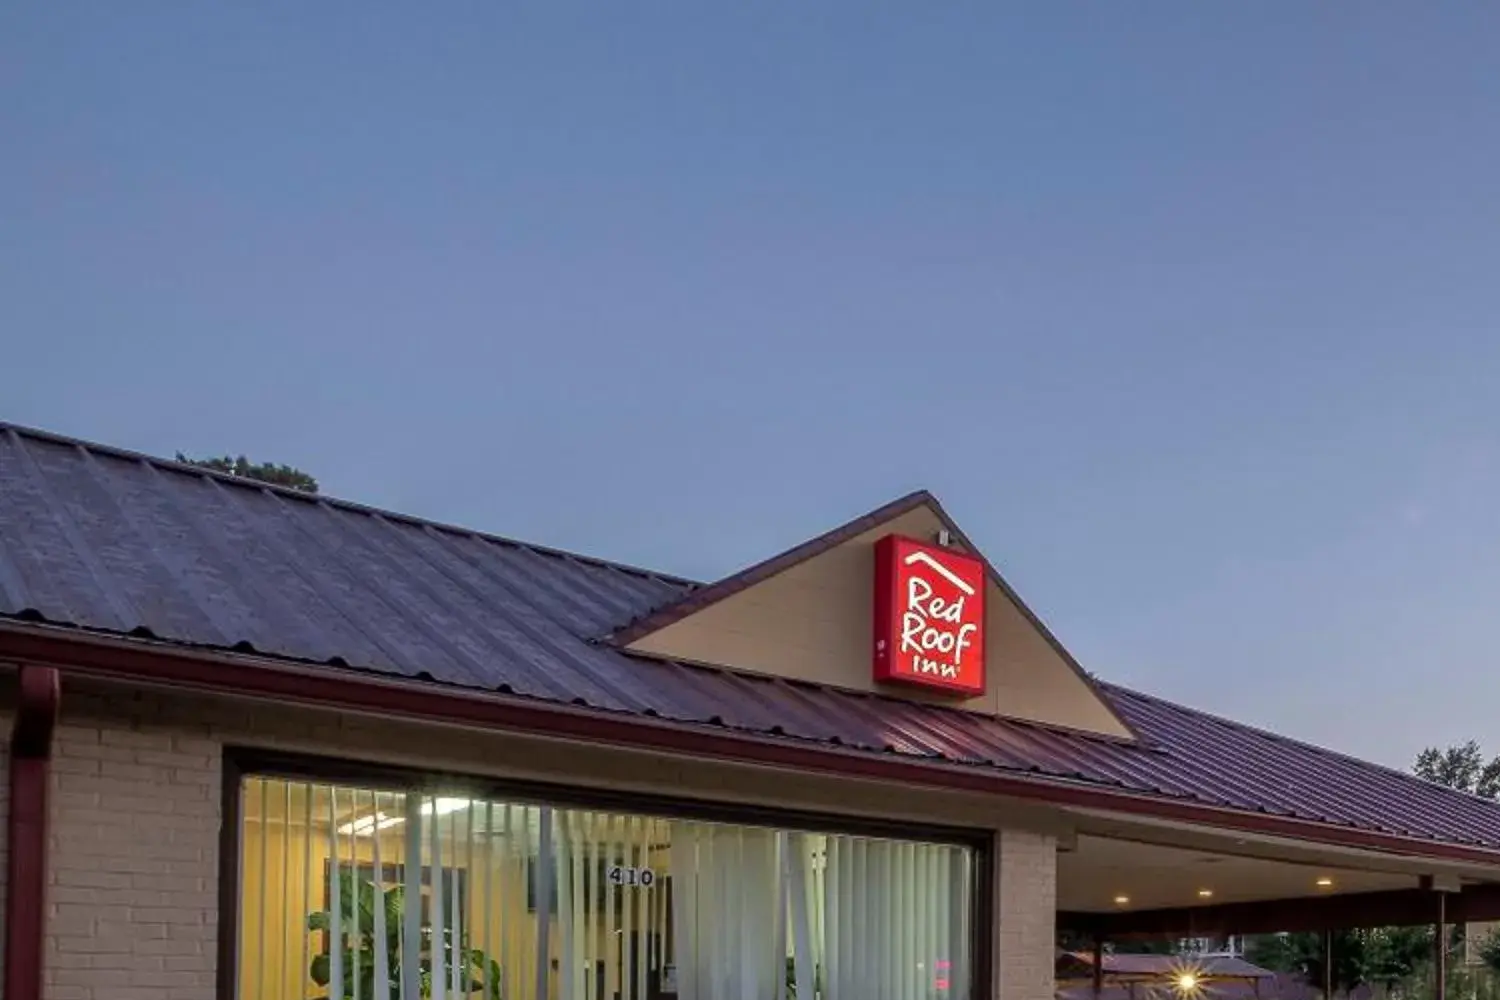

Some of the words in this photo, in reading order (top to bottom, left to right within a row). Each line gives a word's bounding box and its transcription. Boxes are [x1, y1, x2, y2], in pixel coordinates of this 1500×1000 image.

[908, 576, 965, 623] Red
[901, 611, 977, 664] Roof
[609, 867, 653, 886] 410
